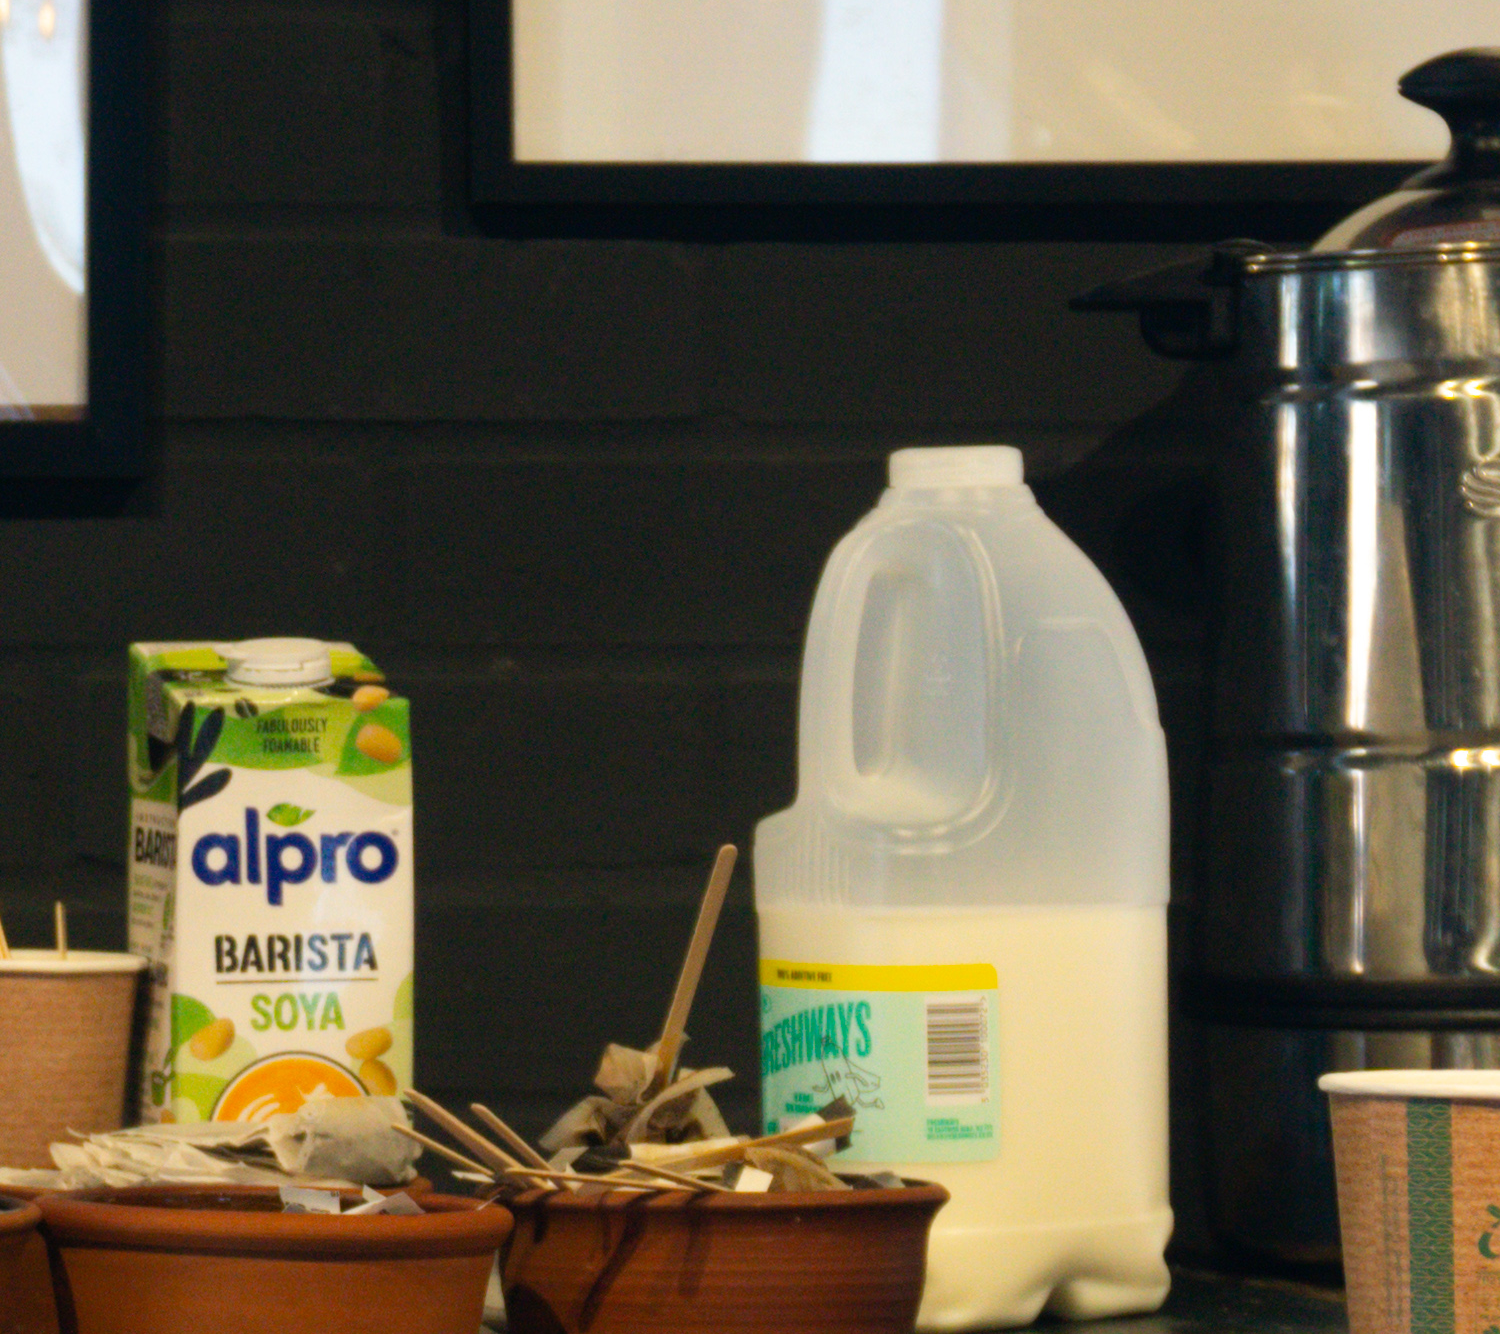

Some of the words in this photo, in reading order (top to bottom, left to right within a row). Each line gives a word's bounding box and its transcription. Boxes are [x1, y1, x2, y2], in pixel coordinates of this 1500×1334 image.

[256, 717, 328, 734] FABULOUSLY
[262, 736, 320, 753] FOAMABLE
[191, 807, 400, 906] alpro
[213, 932, 379, 975] BARISTA
[250, 993, 346, 1033] SOYA
